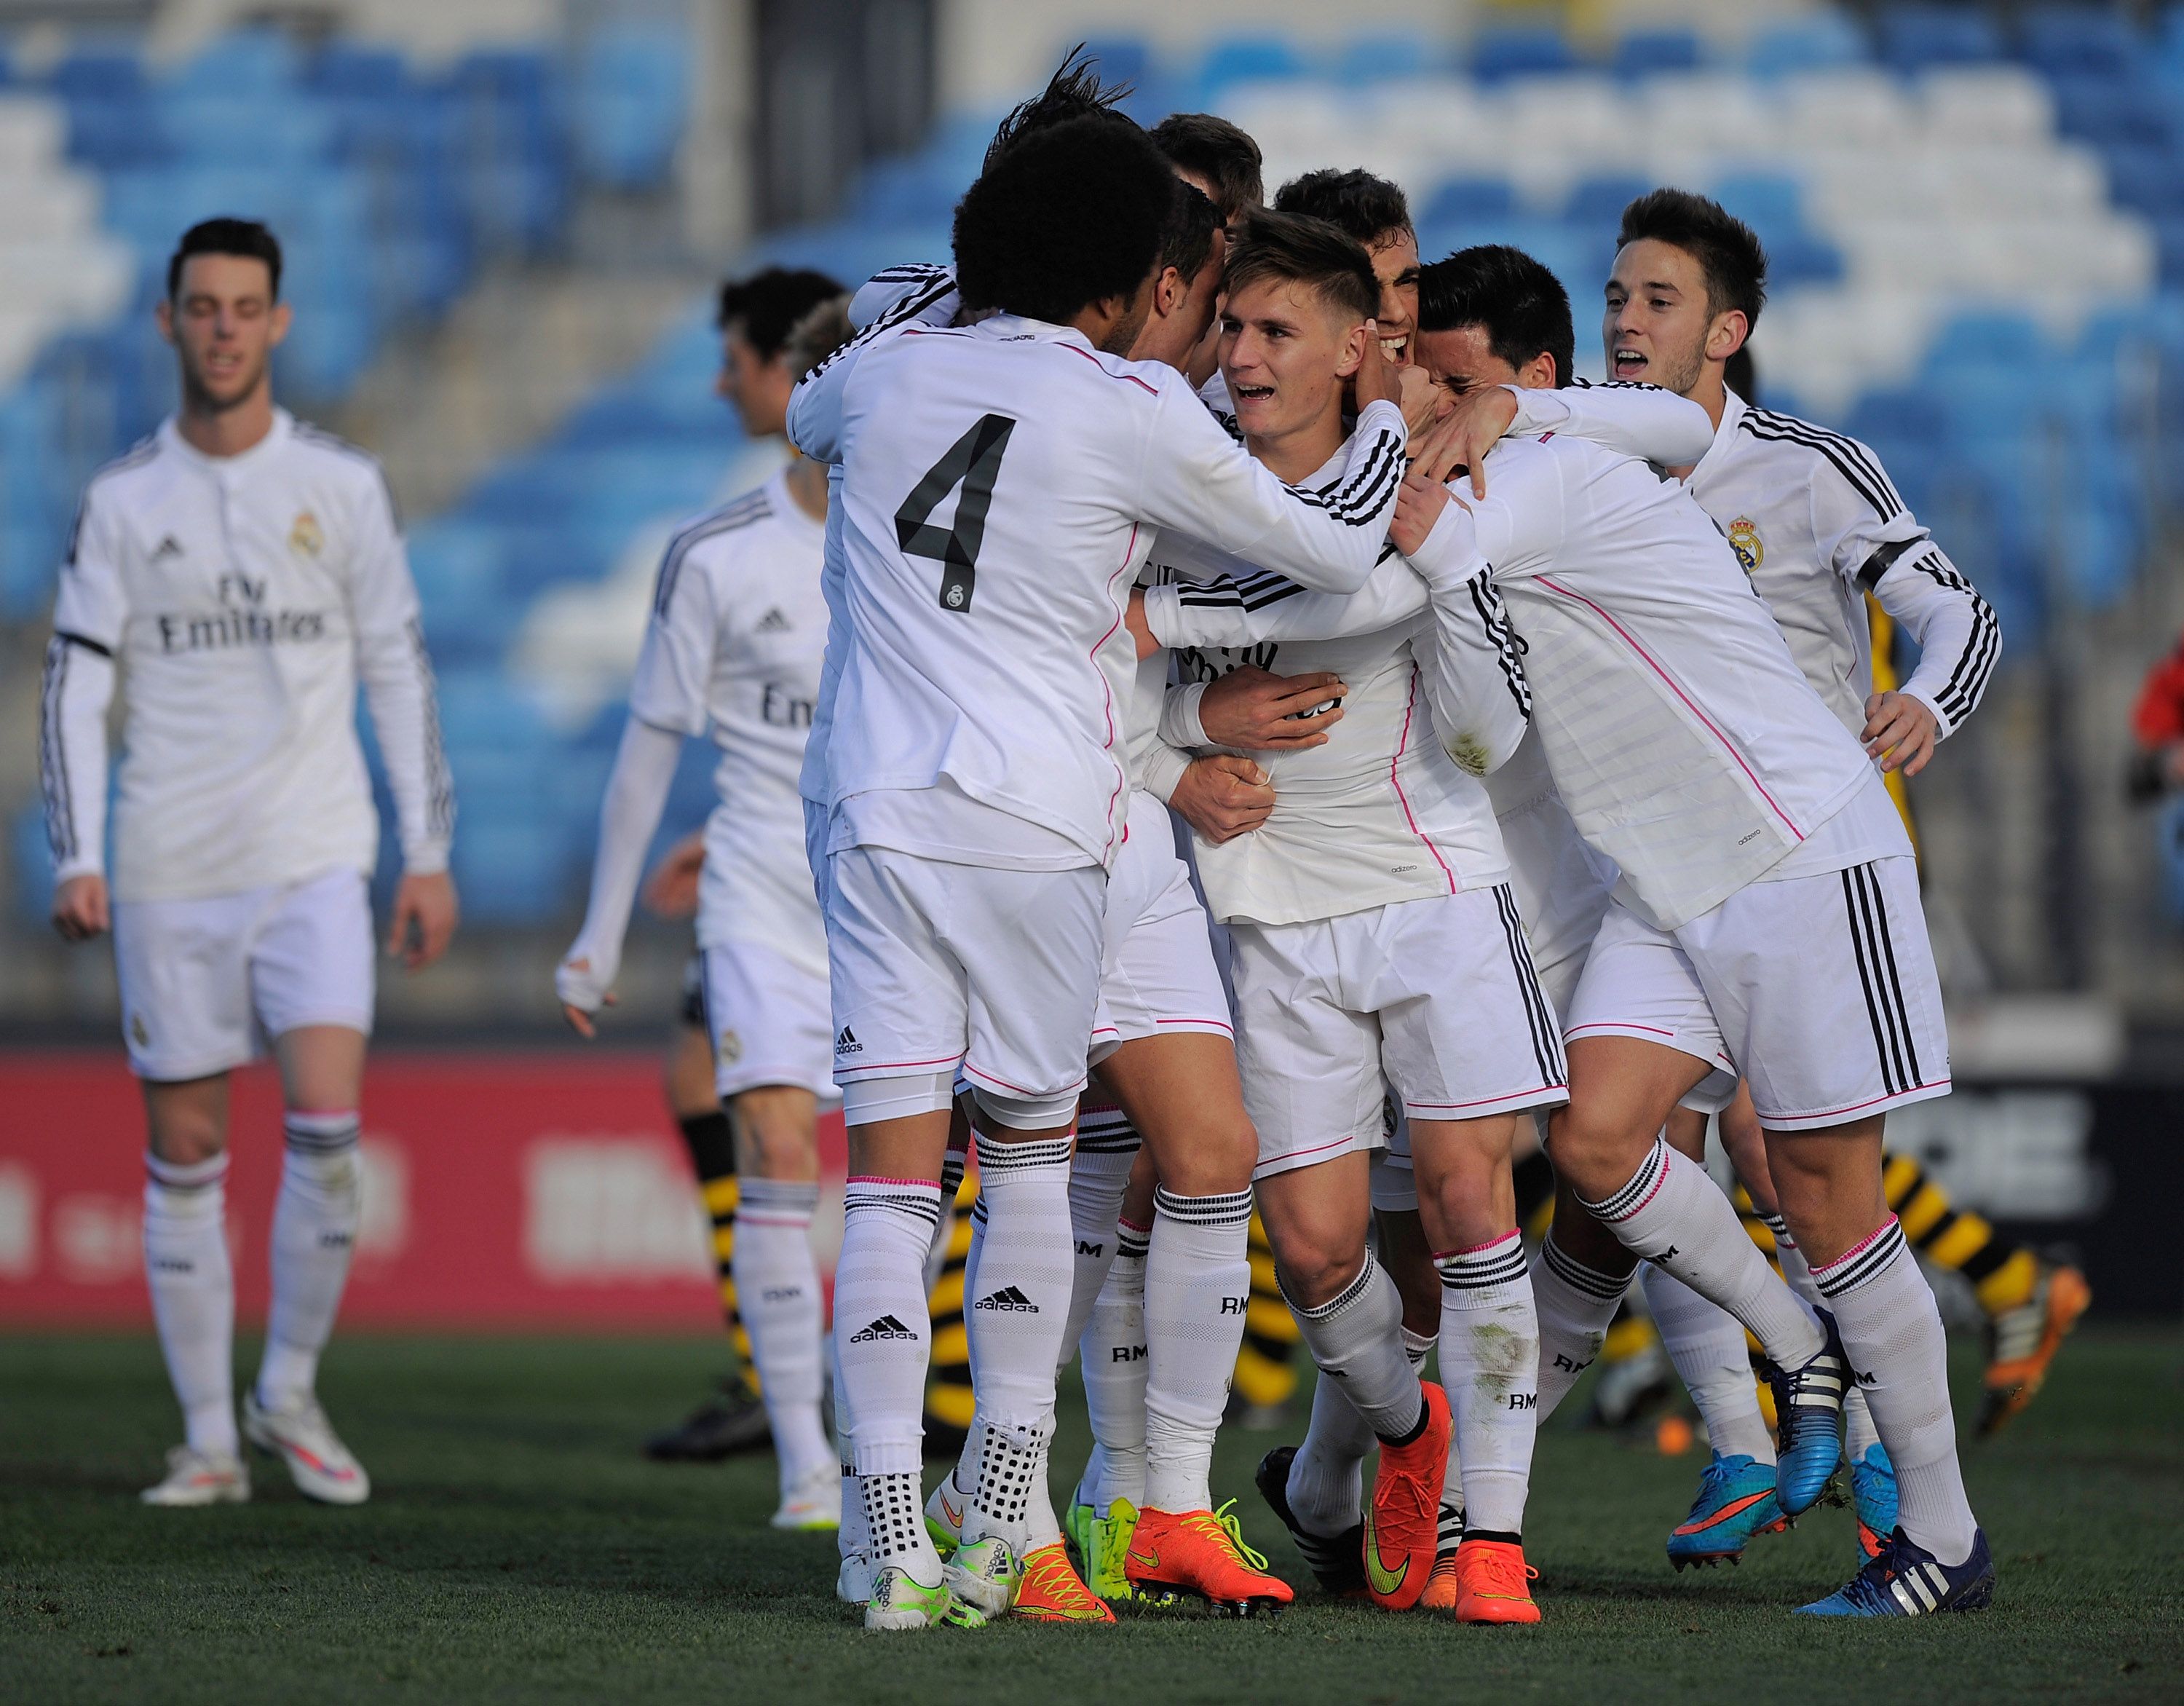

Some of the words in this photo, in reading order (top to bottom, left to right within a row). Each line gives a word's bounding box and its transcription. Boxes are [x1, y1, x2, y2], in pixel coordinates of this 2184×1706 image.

[894, 413, 1017, 613] 4
[1738, 829, 1761, 846] adizero
[1391, 865, 1417, 873] adizero
[836, 1042, 863, 1055] adidas
[974, 1300, 1040, 1314] adidas
[1219, 1296, 1250, 1315] RM
[850, 1330, 918, 1343] adidas
[1112, 1343, 1150, 1363] RM
[1508, 1392, 1538, 1410] RM
[984, 1544, 1003, 1578] adidas
[882, 1571, 894, 1608] adidas
